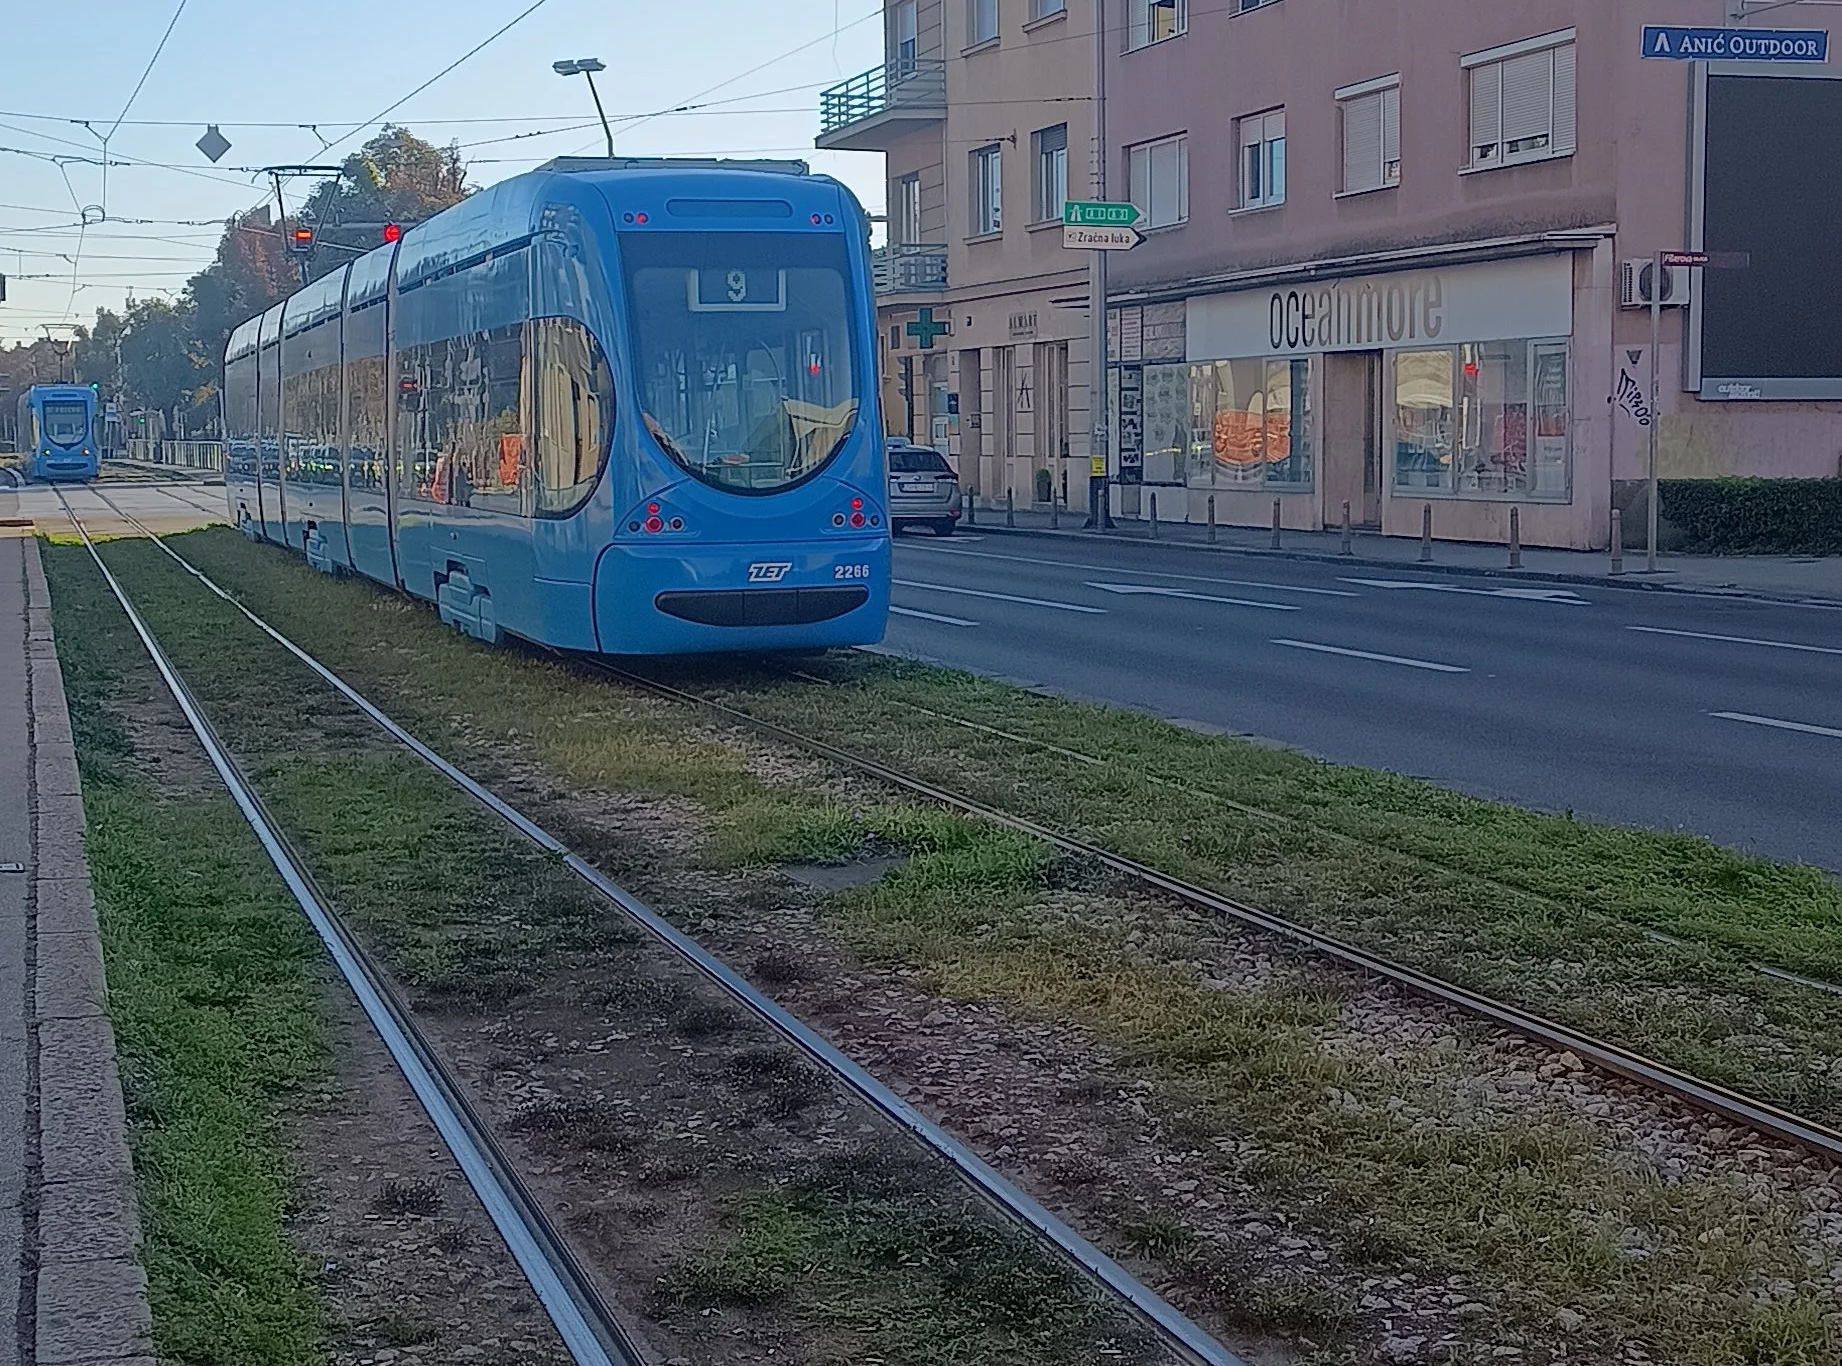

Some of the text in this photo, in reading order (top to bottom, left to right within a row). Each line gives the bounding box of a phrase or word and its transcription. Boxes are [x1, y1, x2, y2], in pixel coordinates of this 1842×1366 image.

[1679, 33, 1818, 56] ANIĆ OUTDOOR
[1077, 231, 1130, 244] Zračna luka
[727, 270, 746, 302] 9
[1270, 276, 1442, 349] oceanmore
[748, 562, 870, 582] ZET 2266
